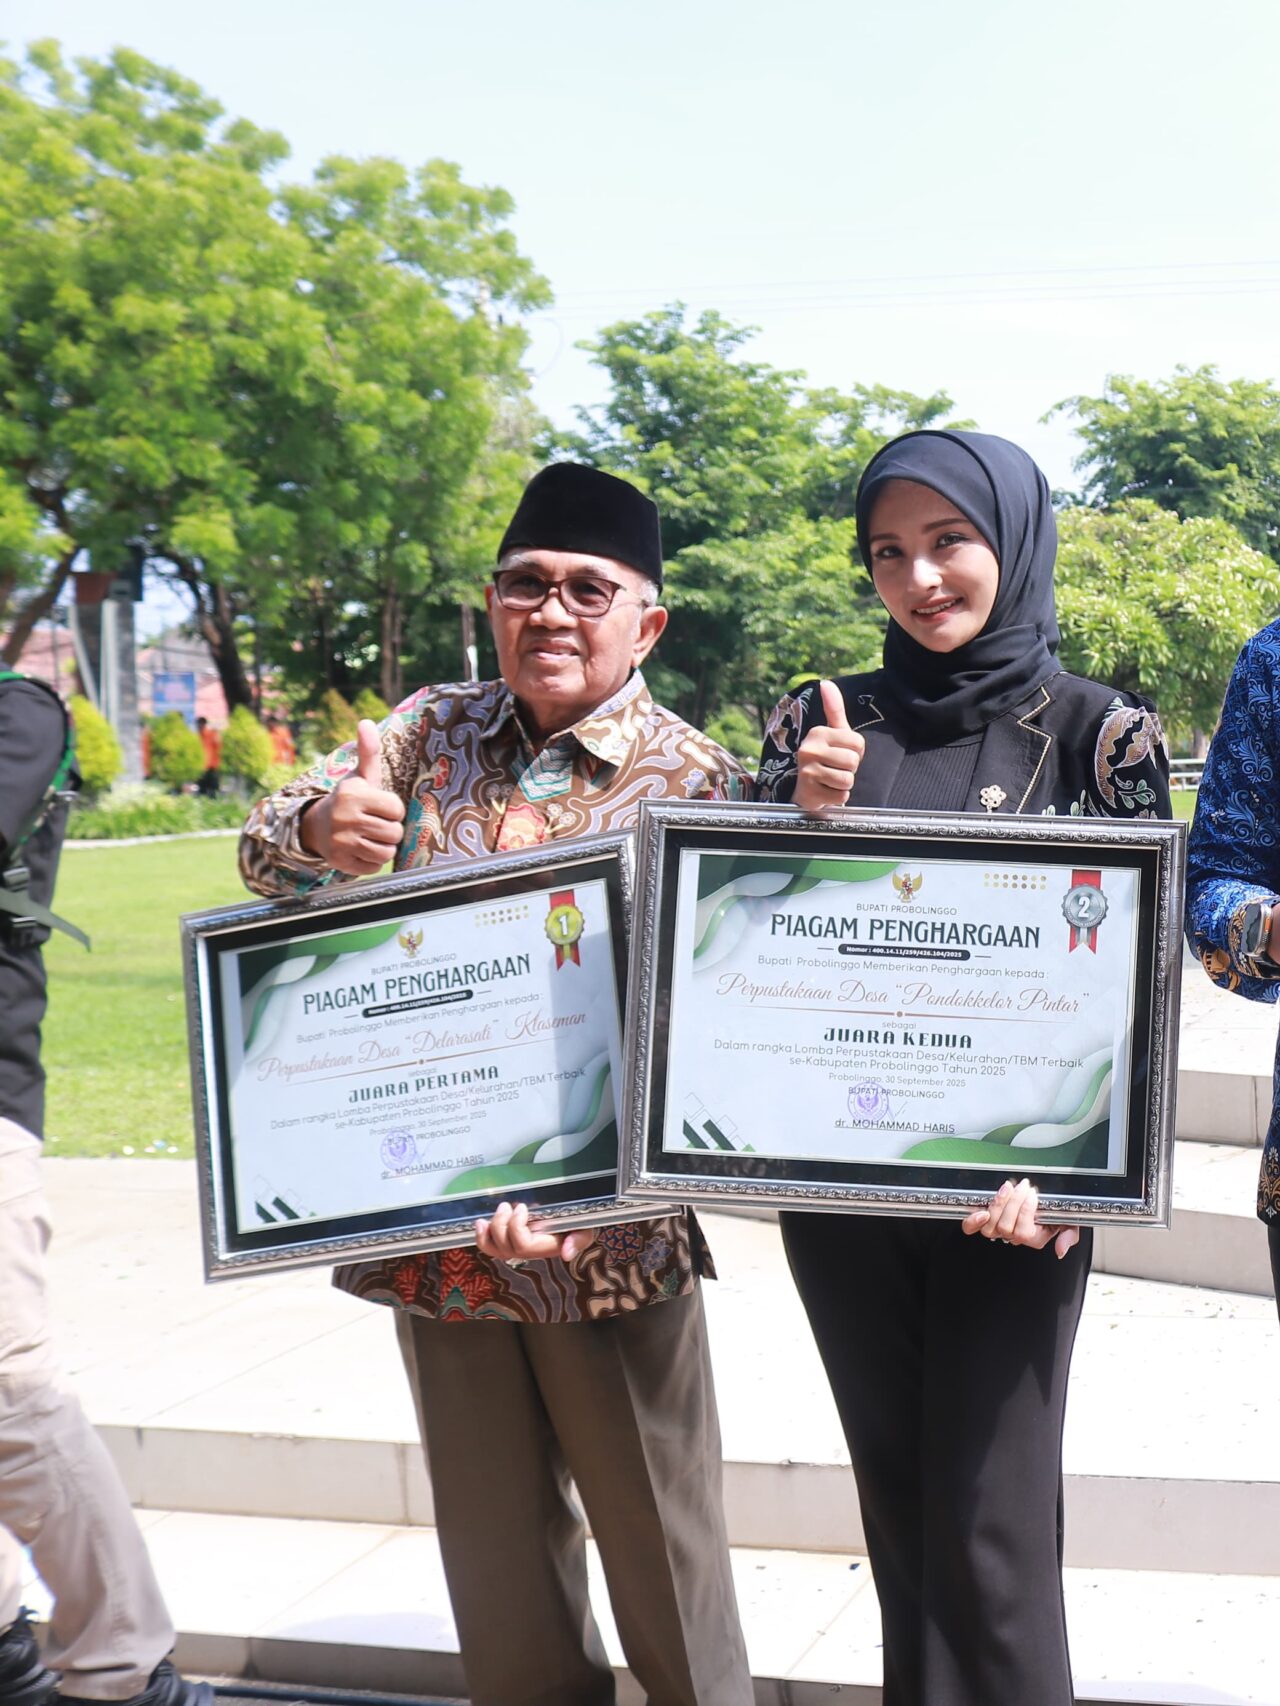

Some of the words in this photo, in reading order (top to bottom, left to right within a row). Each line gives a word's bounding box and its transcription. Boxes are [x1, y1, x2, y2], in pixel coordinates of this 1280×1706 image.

[856, 903, 887, 912] BUPATI
[891, 905, 957, 915] PROBOLINGGO
[1077, 896, 1090, 918] 2
[559, 915, 568, 936] 1
[770, 913, 858, 939] PIAGAM
[869, 918, 1040, 948] PENGHARGAAN
[758, 955, 791, 967] Bupati
[796, 957, 860, 971] Probolinggo
[863, 960, 928, 972] Memberikan
[931, 964, 1001, 977] Penghargaan
[303, 982, 376, 1014] PIAGAM
[385, 953, 530, 999] PENGHARGAAN
[715, 972, 832, 1005] Perpustakaan
[837, 978, 889, 1003] Desa
[296, 1030, 324, 1044] Bupati
[328, 1020, 382, 1039] Probolinggo
[882, 1020, 916, 1029] sebagai
[824, 1027, 894, 1044] JUARA
[903, 1032, 971, 1048] KEDUA
[256, 1043, 353, 1086] Perpustakaan
[357, 1035, 399, 1064] Desa
[714, 1039, 749, 1050] Dalam
[752, 1041, 792, 1054] rangka
[794, 1043, 833, 1055] Lomba
[835, 1046, 913, 1061] Perpustakaan
[916, 1050, 1037, 1065] Desa/Kelurahan/TBM
[1041, 1056, 1084, 1068] Terbaik
[789, 1055, 867, 1069] se-Kabupaten
[870, 1059, 938, 1074] Probolinggo
[941, 1063, 977, 1074] Tahun
[980, 1065, 1006, 1075] 2025
[348, 1080, 408, 1103] JUARA
[415, 1064, 499, 1092] PERTAMA
[885, 1075, 895, 1083] 30
[897, 1076, 943, 1087] September
[946, 1078, 966, 1087] 2025
[270, 1116, 299, 1129] Dalam
[302, 1110, 335, 1126] rangka
[337, 1103, 370, 1118] Lomba
[372, 1092, 438, 1114] Perpustakaan
[548, 1066, 585, 1082] Terbaik
[881, 1088, 944, 1099] PROBOLINGGO
[335, 1109, 401, 1130] se-Kabupaten
[402, 1099, 461, 1120] Probolinggo
[464, 1093, 494, 1107] Tahun
[497, 1089, 519, 1102] 2025
[834, 1118, 848, 1126] dr.
[852, 1119, 919, 1130] MOHAMMAD
[923, 1123, 955, 1132] HARIS
[396, 1158, 453, 1176] MOHAMMAD
[456, 1153, 484, 1166] HARIS
